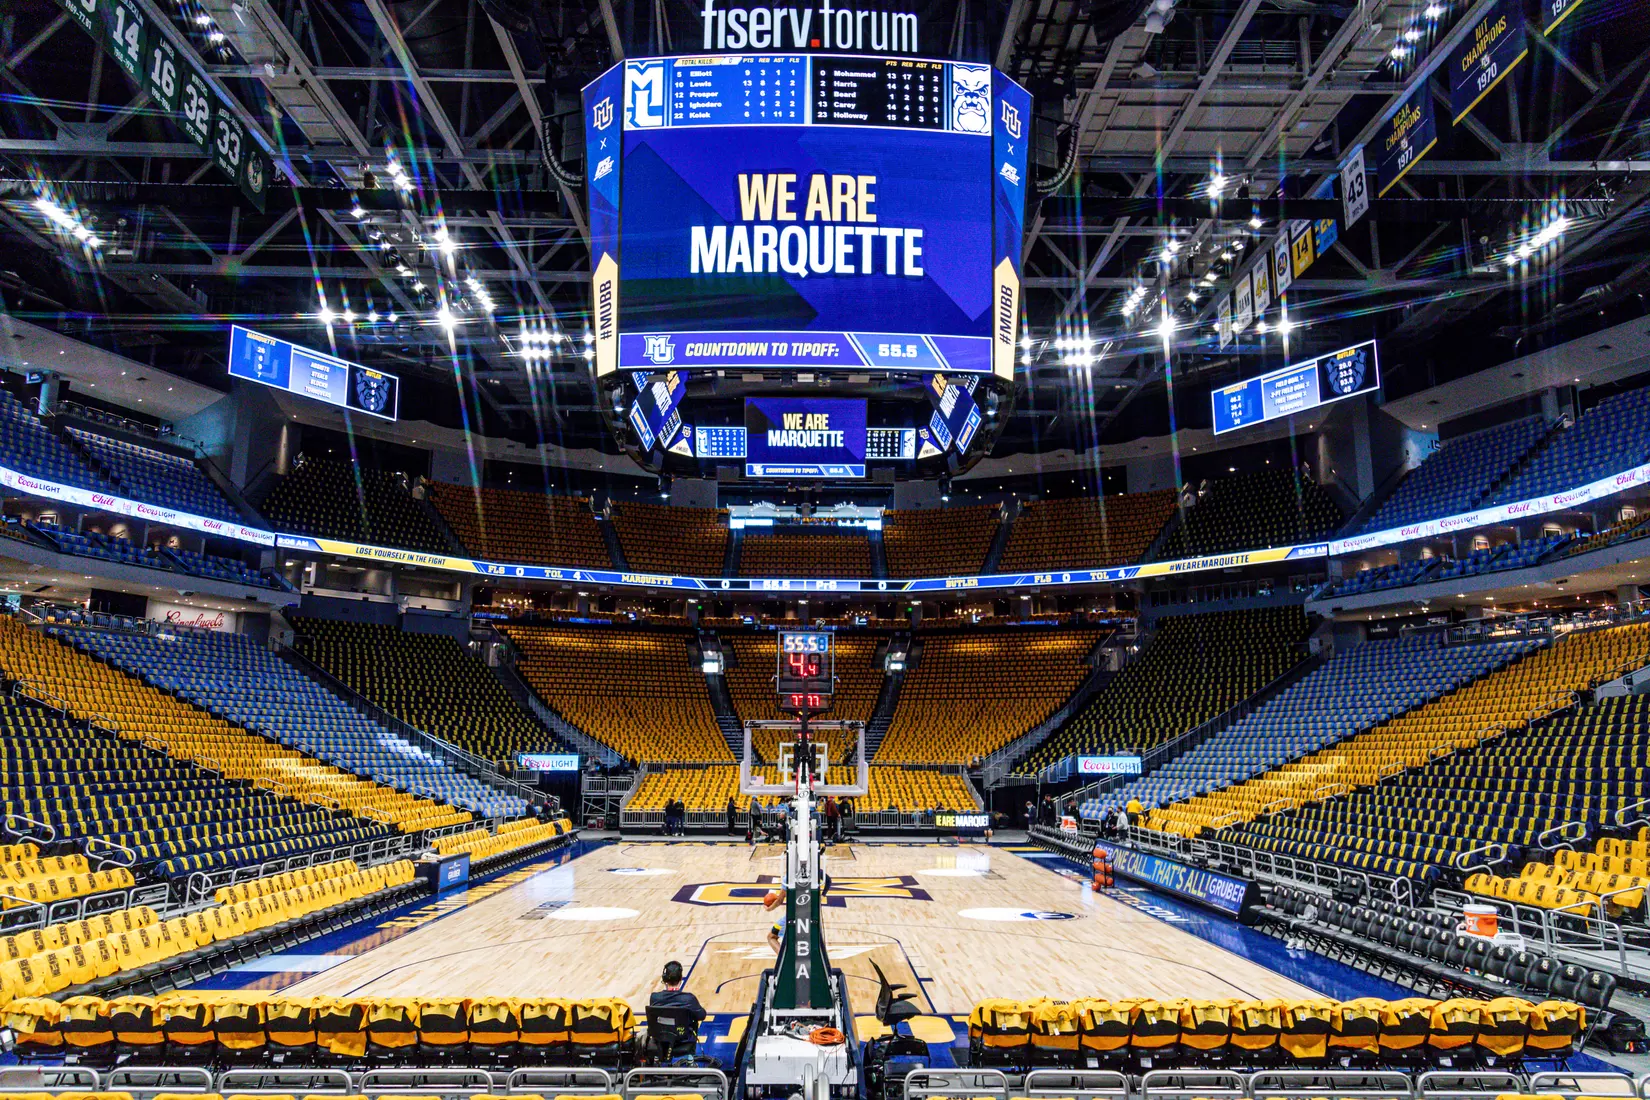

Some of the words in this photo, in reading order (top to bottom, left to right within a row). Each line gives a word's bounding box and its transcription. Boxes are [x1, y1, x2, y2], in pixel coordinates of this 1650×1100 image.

[113, 6, 140, 61] 14
[1475, 17, 1488, 41] NIT
[1462, 15, 1507, 72] CHAMPIONS
[151, 48, 176, 97] 16
[833, 70, 876, 78] Mohammed
[1477, 62, 1497, 92] 1970
[689, 91, 719, 99] Prosper
[184, 84, 209, 135] 32
[689, 101, 722, 109] Ighodaro
[833, 112, 868, 120] Holloway
[1393, 103, 1411, 129] NCAA
[1386, 106, 1421, 151] CHAMPIONS
[217, 121, 240, 166] 33
[1397, 145, 1413, 170] 1977
[1348, 172, 1364, 203] 43
[737, 173, 798, 221] WE
[804, 174, 877, 223] ARE
[690, 225, 923, 278] MARQUETTE
[1297, 235, 1308, 260] 14
[1256, 272, 1267, 298] 44
[600, 279, 612, 341] #MUBB
[999, 284, 1013, 346] #MUBB
[685, 342, 769, 357] COUNTDOWN
[771, 343, 789, 357] TO
[791, 341, 839, 357] TIPOFF:
[878, 343, 917, 358] 55.5
[1336, 349, 1356, 360] BUTLER
[1275, 380, 1287, 389] FIELD
[1281, 387, 1293, 396] FIELD
[783, 413, 803, 430] WE
[804, 413, 829, 431] ARE
[768, 430, 844, 448] MARQUETTE
[17, 475, 39, 490] Coors
[39, 484, 61, 494] LIGHT
[1616, 470, 1636, 485] Chill
[92, 493, 116, 507] Chill
[1553, 492, 1575, 505] Coors
[1575, 488, 1591, 499] LIGHT
[137, 503, 158, 516] Coors
[158, 511, 176, 520] LIGHT
[1507, 502, 1530, 515] Chill
[203, 519, 222, 530] Chill
[1439, 517, 1460, 528] Coors
[1460, 514, 1479, 523] LIGHT
[240, 526, 258, 538] Coors
[257, 533, 273, 541] LIGHT
[1401, 525, 1420, 537] Chill
[295, 539, 309, 548] AM
[1343, 538, 1362, 548] Coors
[1360, 536, 1376, 545] LIGHT
[355, 546, 372, 556] LOSE
[374, 548, 406, 560] YOURSELF
[407, 553, 415, 561] IN
[416, 554, 426, 563] THE
[428, 555, 446, 566] FIGHT
[1169, 554, 1250, 572] #WEAREMARQUETTE
[487, 565, 505, 575] FLS
[516, 567, 524, 577] 0
[544, 569, 563, 579] TOL
[573, 571, 581, 580] 4
[1034, 574, 1052, 584] FLS
[1062, 573, 1071, 583] 0
[1090, 571, 1109, 581] TOL
[1118, 569, 1126, 578] 4
[621, 574, 673, 586] MARQUETTE
[721, 579, 730, 589] 0
[878, 581, 887, 590] 0
[945, 578, 978, 588] BUTLER
[786, 636, 817, 651] 55.5
[523, 758, 550, 769] Coors
[551, 760, 574, 768] LIGHT
[1083, 760, 1110, 770] Coors
[1112, 763, 1139, 773] LIGHT
[941, 815, 955, 826] ARE
[1112, 848, 1127, 870] ONE
[1153, 860, 1187, 890] THAT'S
[1186, 867, 1211, 898] ALL!
[1209, 878, 1246, 904] GRUBER
[797, 918, 810, 979] NBA
